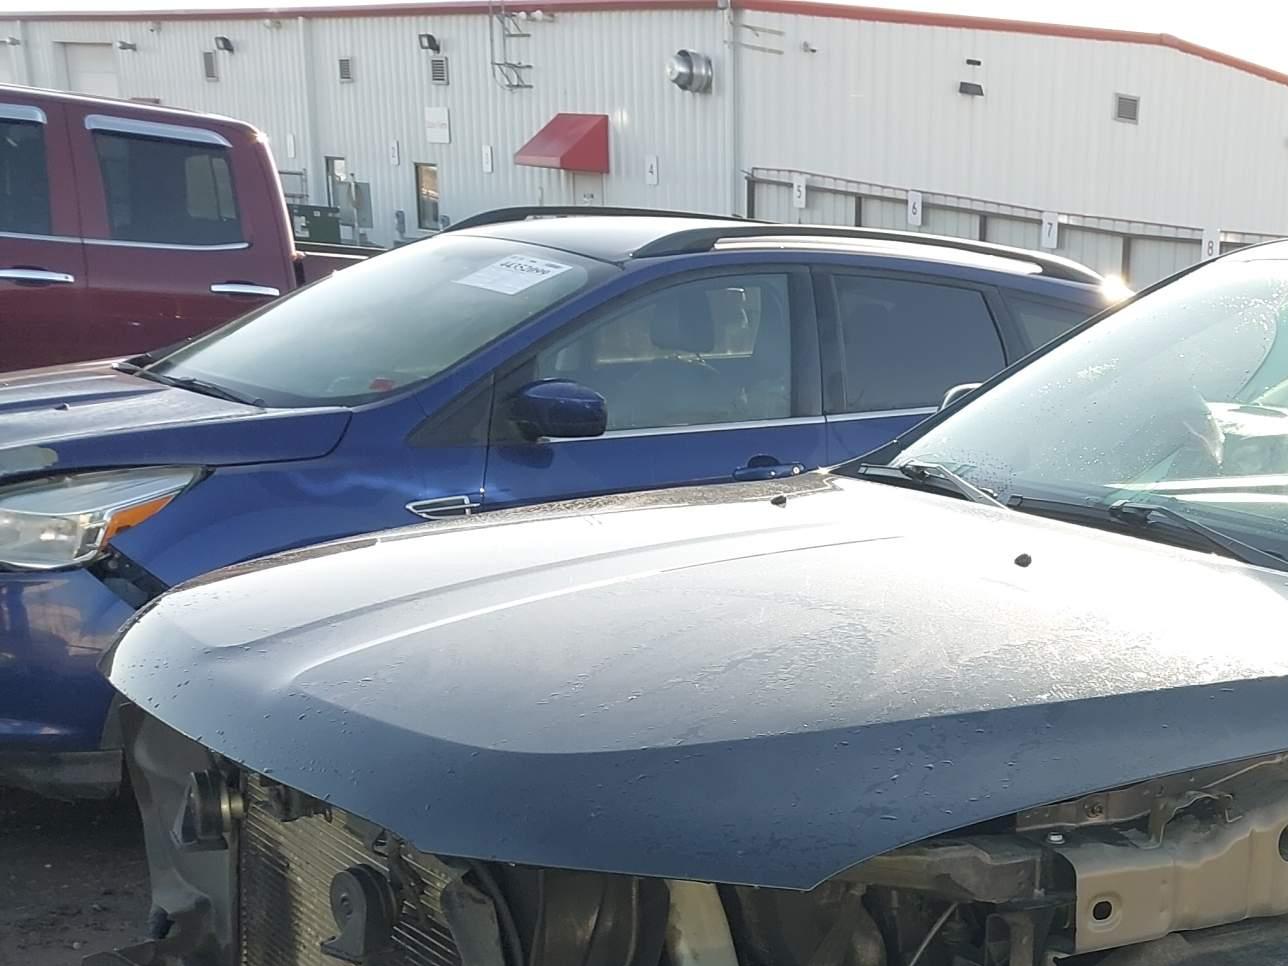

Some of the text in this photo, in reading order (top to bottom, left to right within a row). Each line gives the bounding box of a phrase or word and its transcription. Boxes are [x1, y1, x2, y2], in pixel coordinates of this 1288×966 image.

[648, 163, 655, 175] 4
[796, 184, 802, 199] 5
[911, 202, 918, 216] 6
[1046, 222, 1053, 238] 7
[1207, 240, 1214, 256] 8
